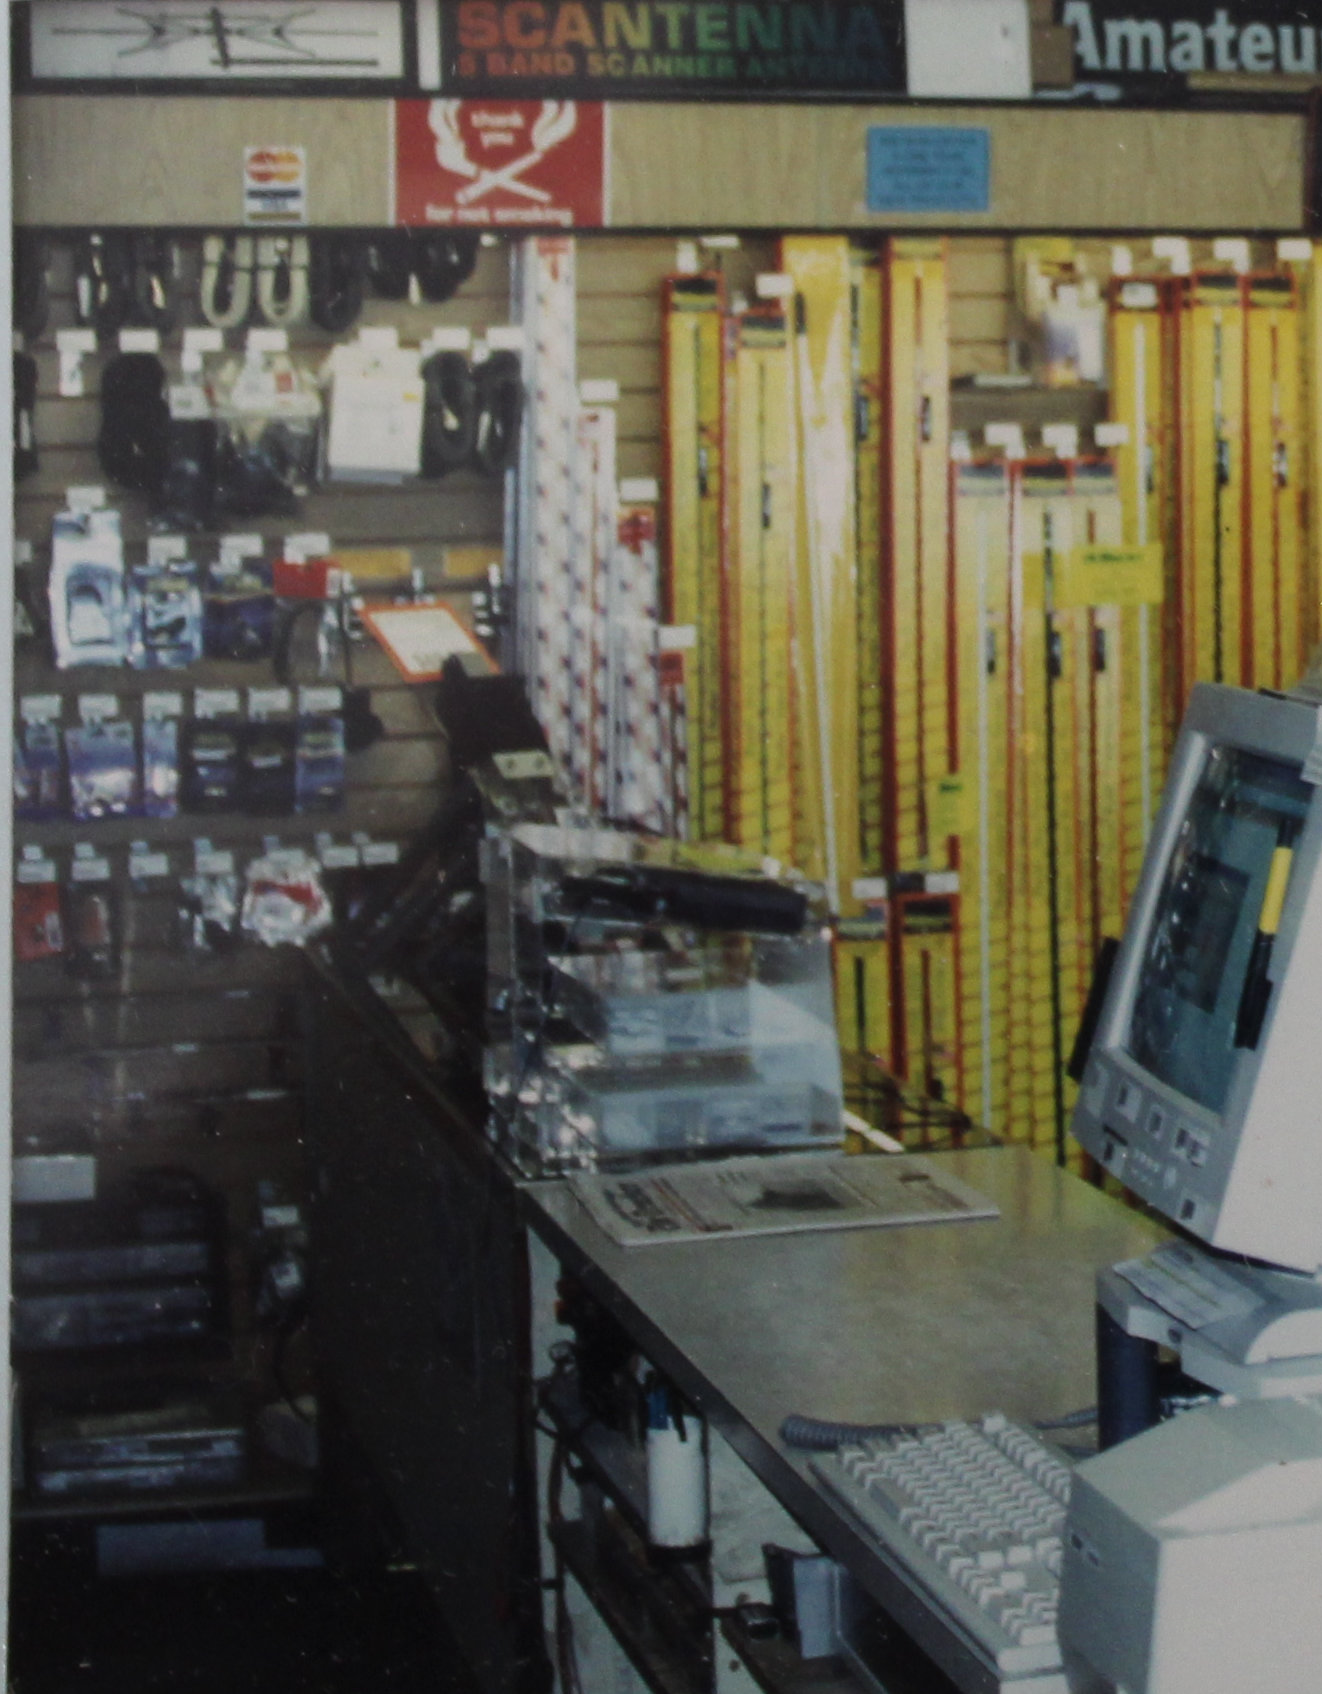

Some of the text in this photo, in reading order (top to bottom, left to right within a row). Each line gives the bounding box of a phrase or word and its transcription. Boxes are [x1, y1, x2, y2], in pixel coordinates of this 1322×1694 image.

[457, 2, 885, 50] SCANTENNA
[486, 52, 576, 76] BAND
[587, 53, 737, 78] SCANNER
